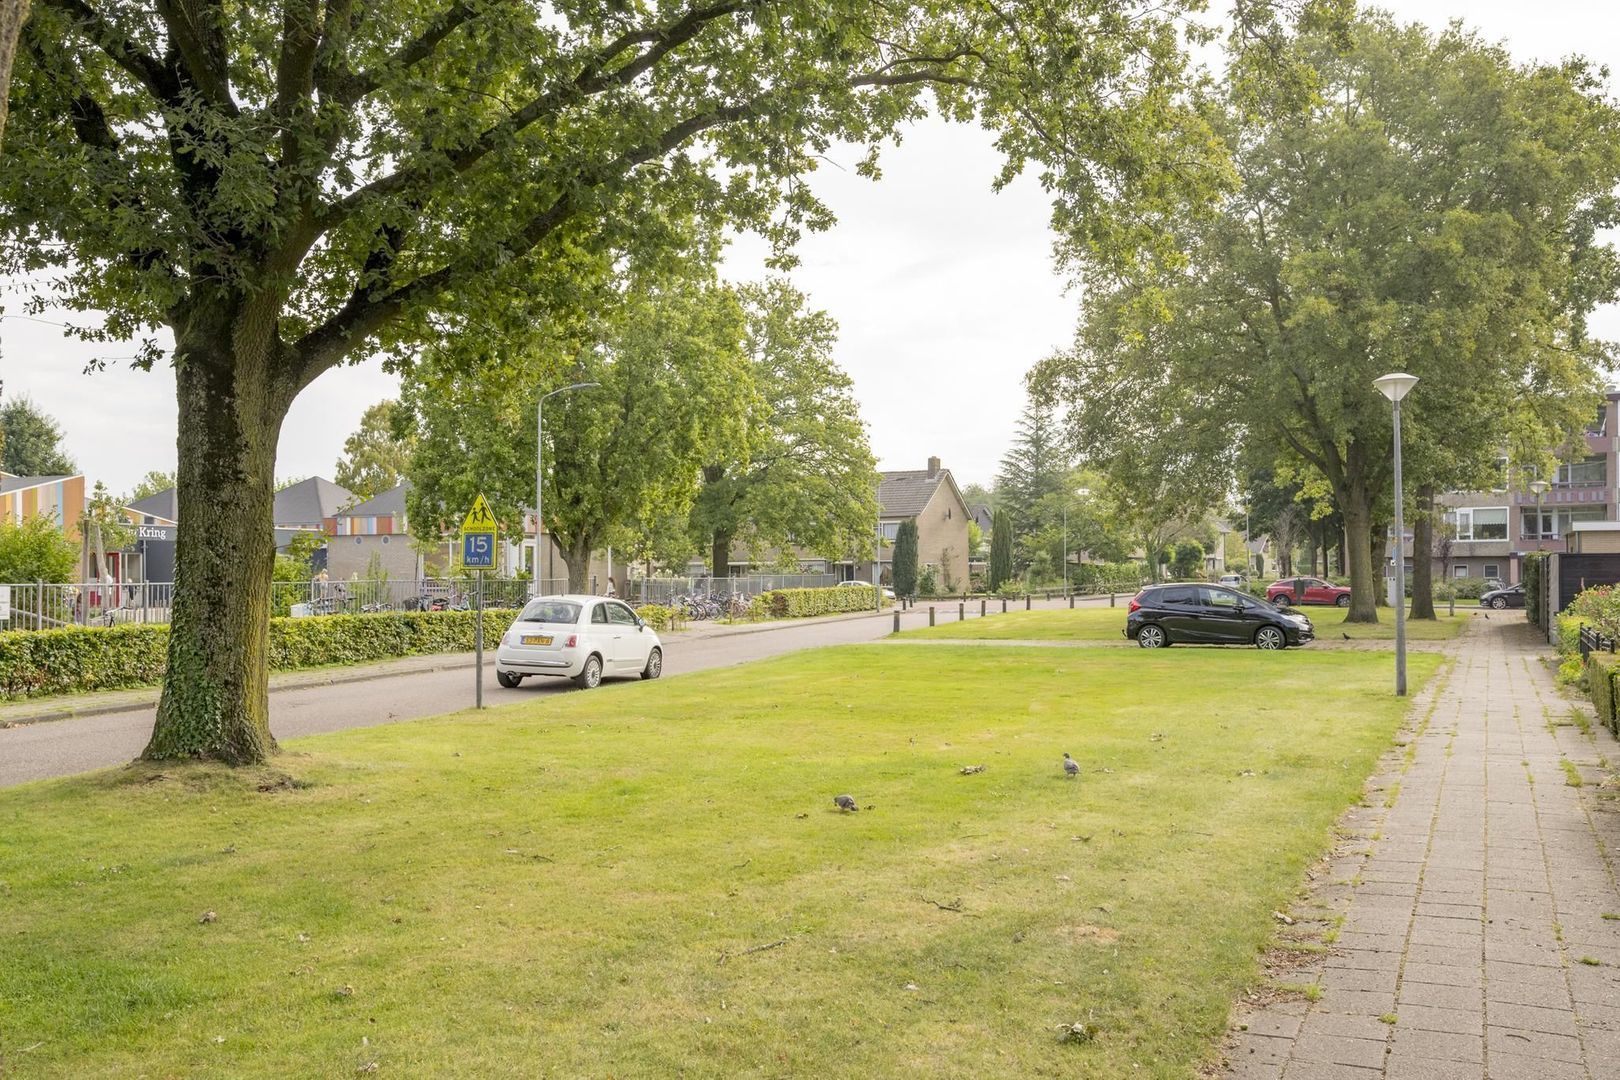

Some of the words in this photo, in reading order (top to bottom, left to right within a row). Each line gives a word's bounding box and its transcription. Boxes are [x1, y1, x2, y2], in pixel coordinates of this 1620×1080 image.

[139, 527, 167, 540] Kring
[469, 536, 488, 553] 15
[466, 555, 490, 564] km/h
